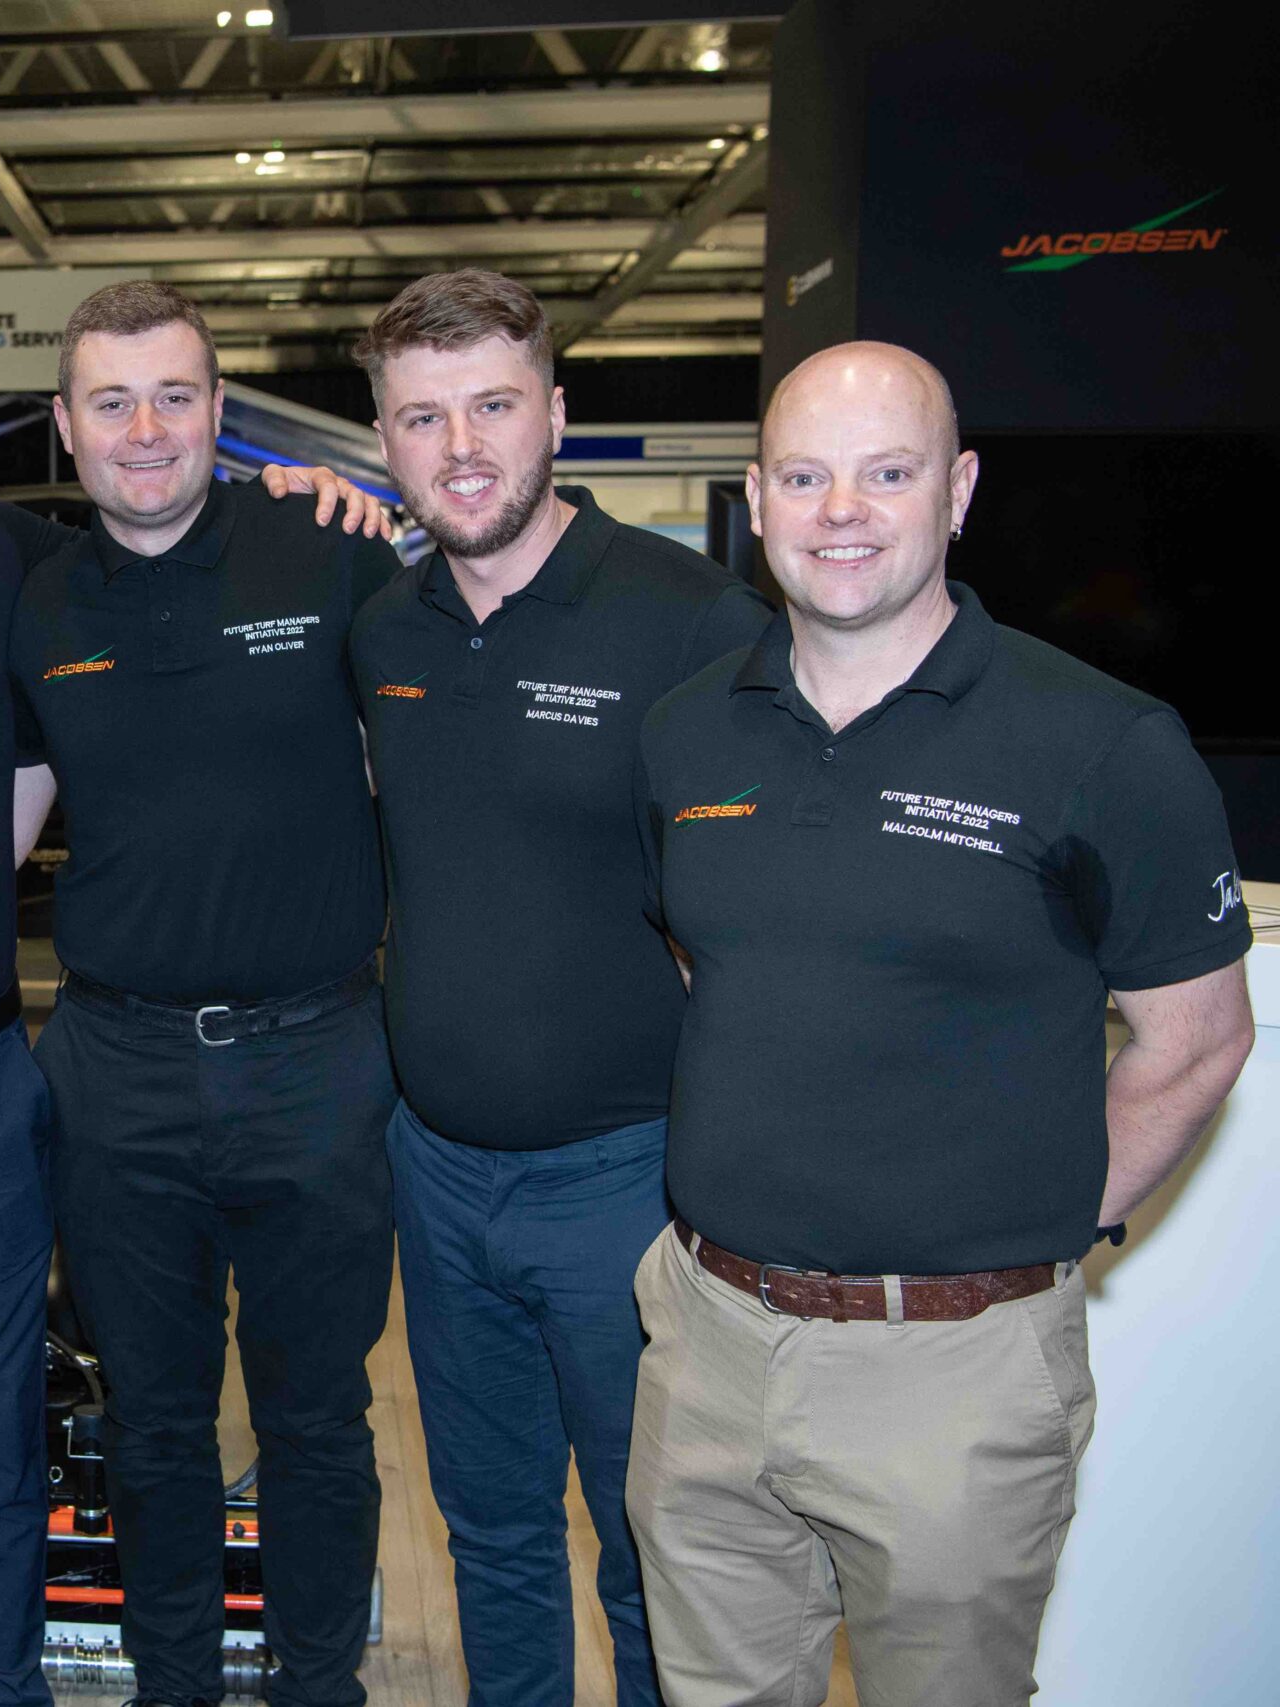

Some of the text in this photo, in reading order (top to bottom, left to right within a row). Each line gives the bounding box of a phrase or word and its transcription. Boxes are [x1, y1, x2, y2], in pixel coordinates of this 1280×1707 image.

[1001, 229, 1220, 257] JACOBSEN
[223, 616, 320, 636] FUTURE TURF MANAGERS
[245, 626, 305, 641] INITIATIVE 2022
[248, 640, 305, 655] RYAN OLIVER
[43, 659, 115, 679] JACOBSEN
[517, 680, 621, 701] FUTURE TURF MANAGERS
[535, 693, 597, 708] INITIATIVE 2022
[525, 709, 599, 726] MARCUS DAVIES
[675, 804, 757, 822] JACOBSEN
[880, 790, 1020, 825] FUTURE TURF MANAGERS
[905, 805, 989, 830] INITIATIVE 2022
[882, 821, 1003, 854] MALCOLM MITCHELL
